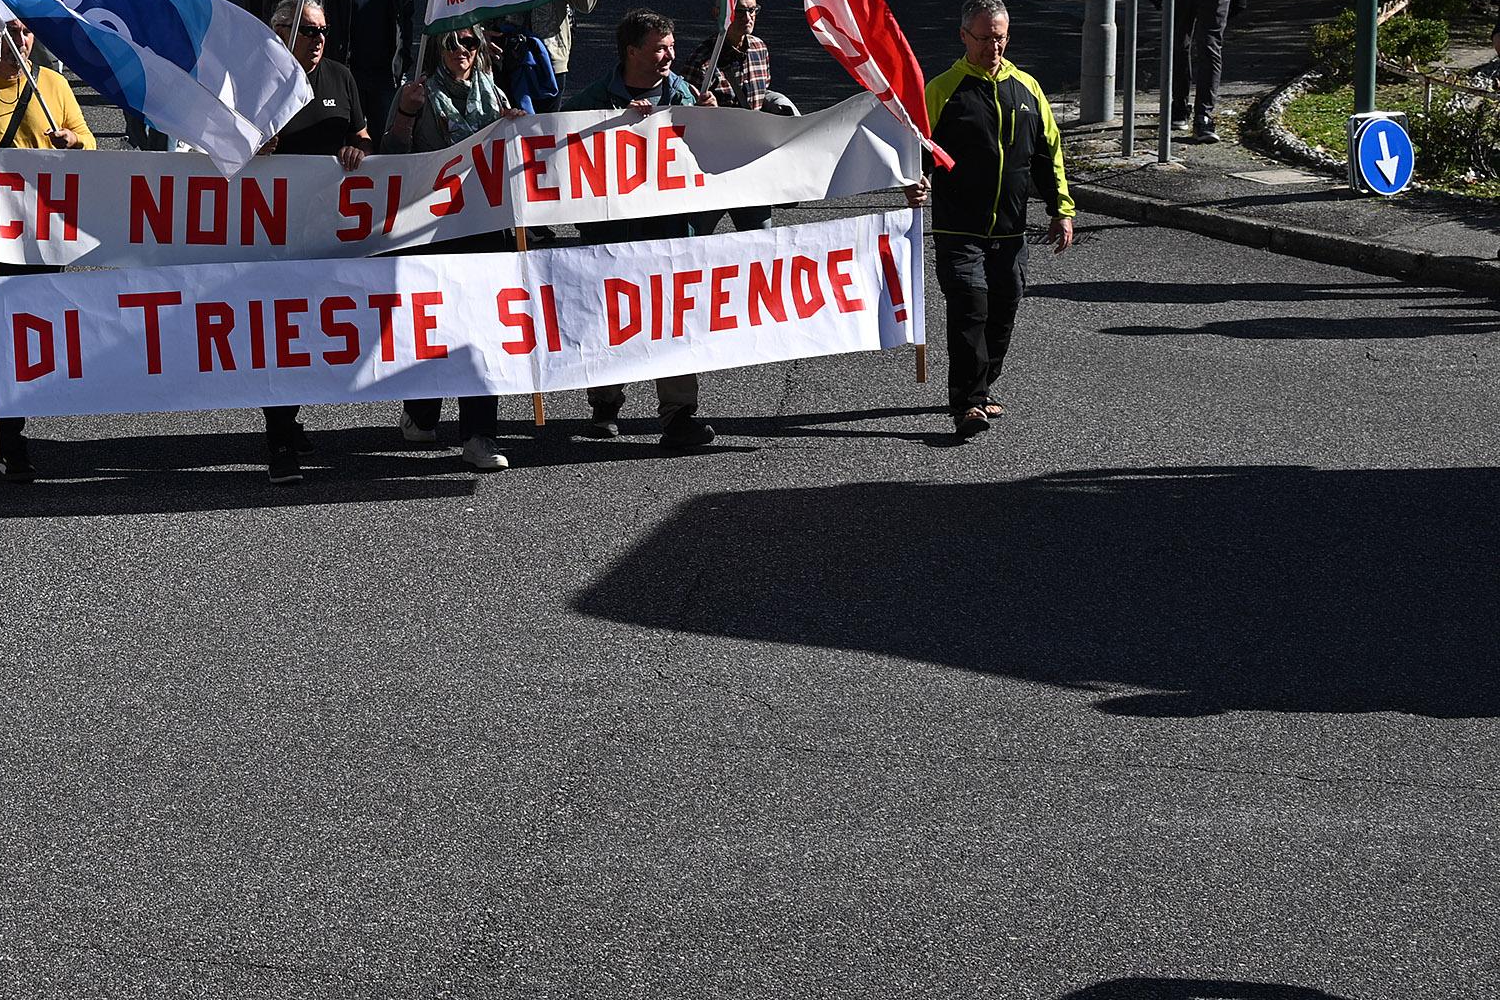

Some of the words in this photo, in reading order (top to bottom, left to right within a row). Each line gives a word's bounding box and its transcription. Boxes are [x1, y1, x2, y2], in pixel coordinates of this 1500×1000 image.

[129, 174, 289, 246] NON
[336, 175, 403, 243] SI
[429, 124, 706, 218] SVENDE.
[11, 310, 84, 383] DI
[117, 290, 450, 376] TRIESTE
[498, 284, 563, 356] SI
